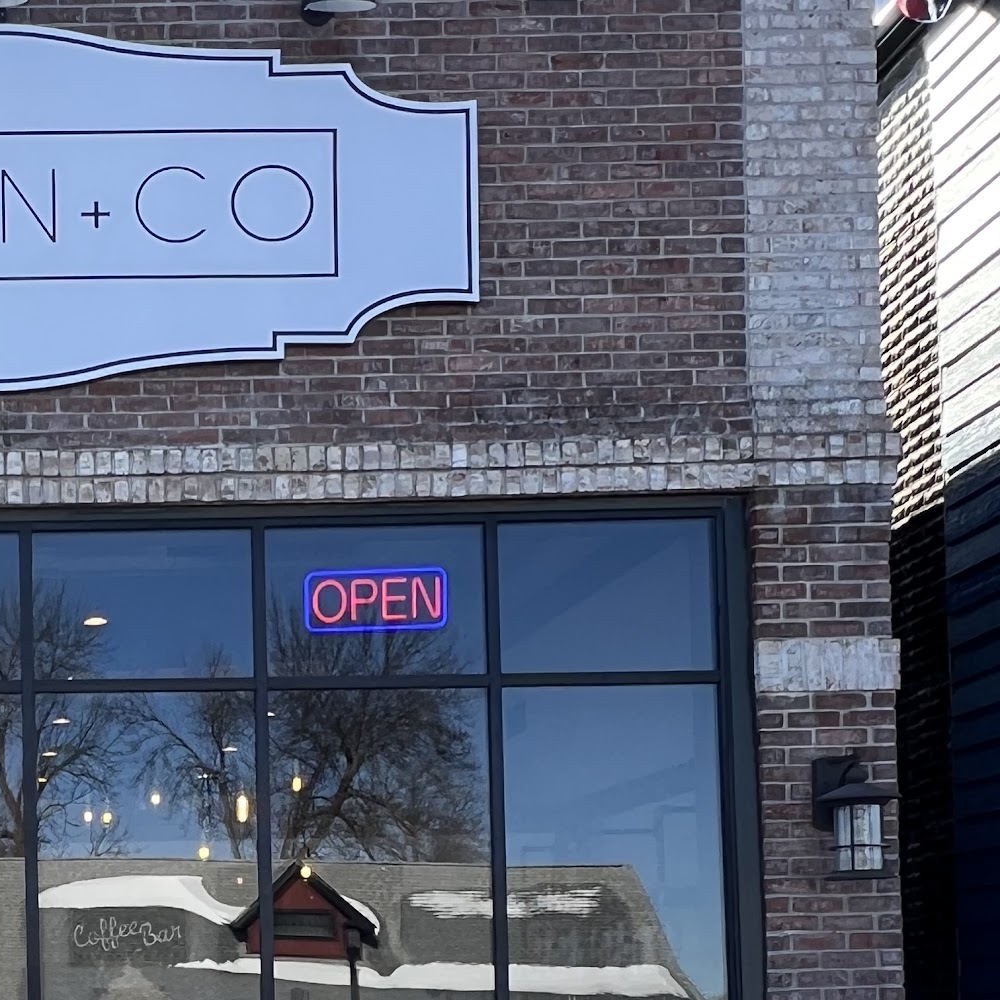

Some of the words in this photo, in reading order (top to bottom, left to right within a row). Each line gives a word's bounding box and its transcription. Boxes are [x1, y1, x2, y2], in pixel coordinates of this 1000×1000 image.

[312, 576, 441, 624] OPEN
[74, 916, 141, 952] Coffee
[140, 921, 182, 946] Bar
